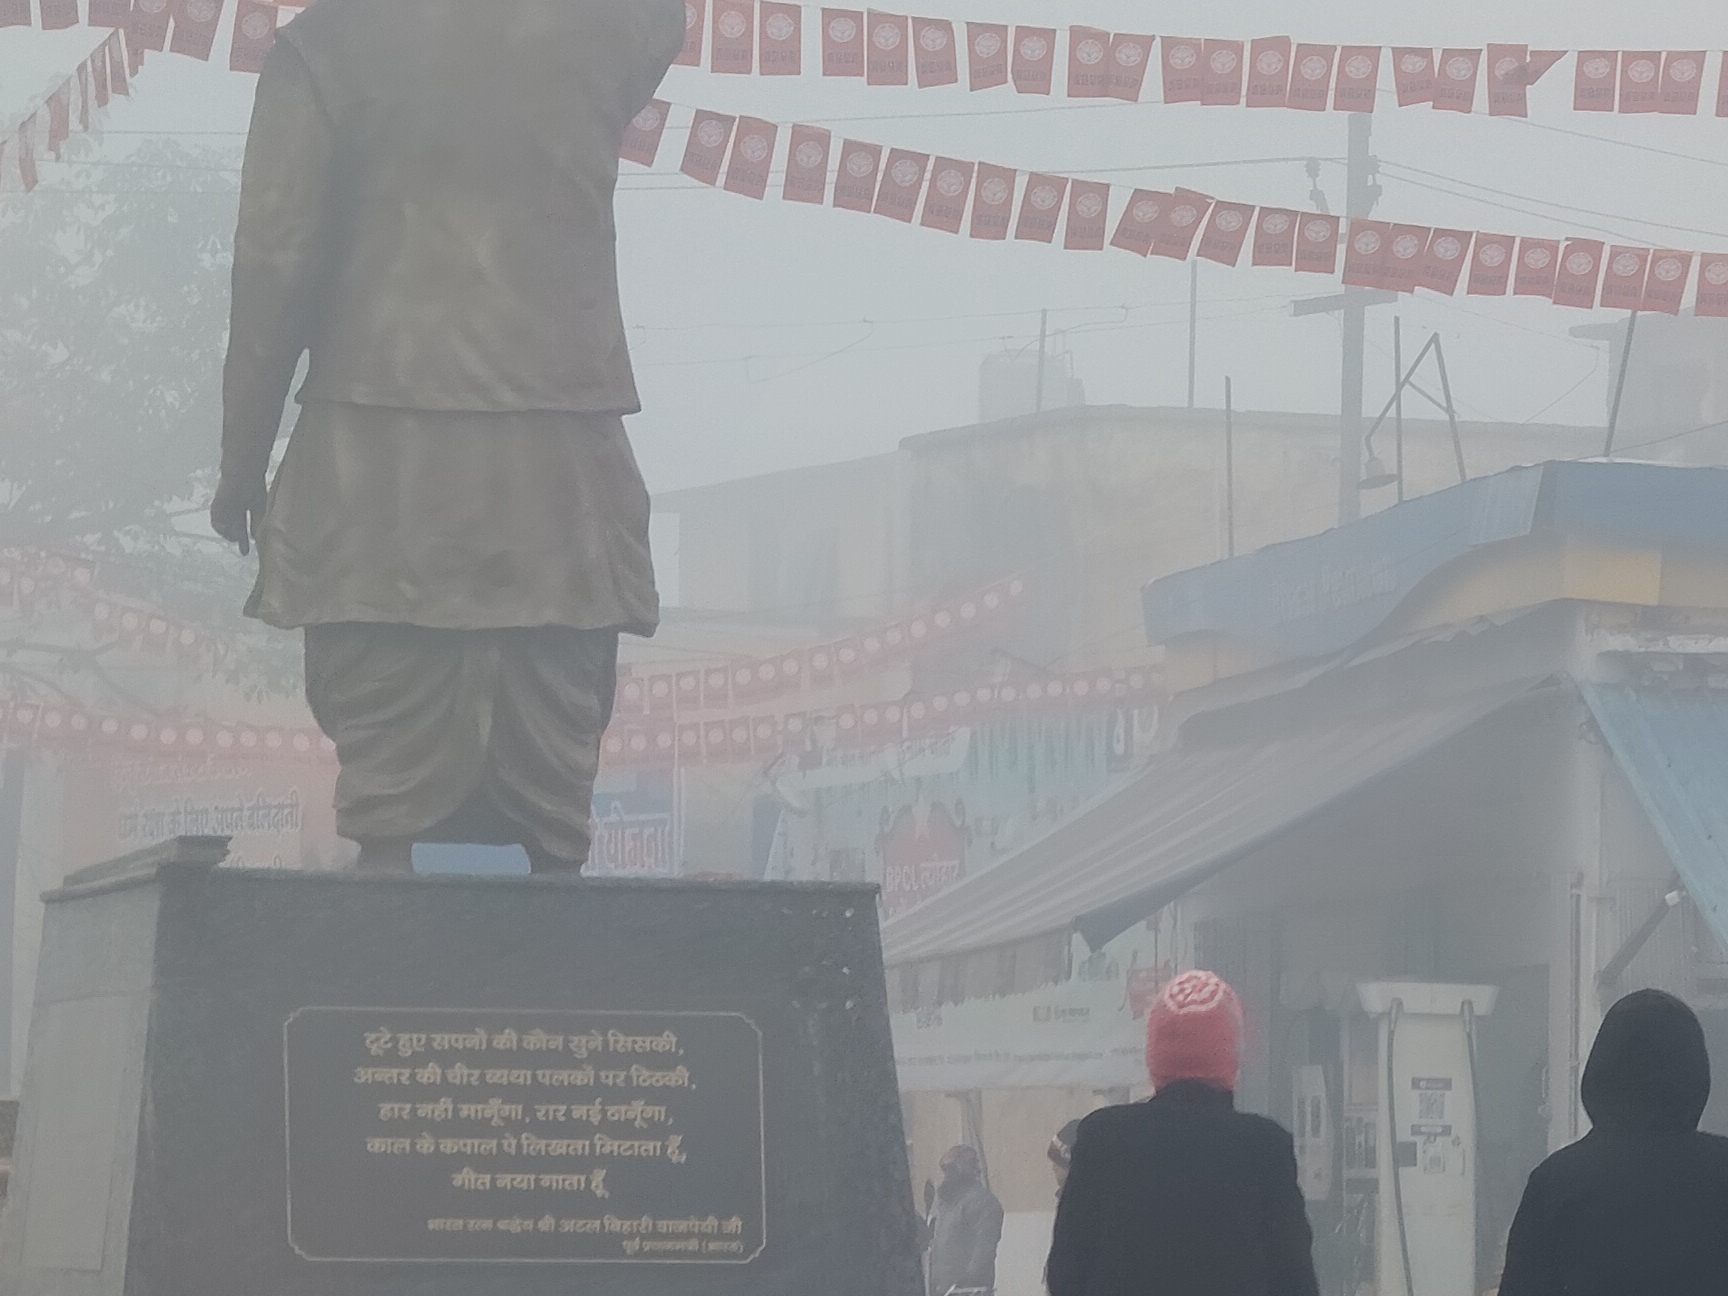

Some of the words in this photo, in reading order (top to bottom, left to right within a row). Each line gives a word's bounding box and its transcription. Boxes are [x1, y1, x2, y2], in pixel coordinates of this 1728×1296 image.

[363, 1026, 393, 1057] टूटे
[396, 1032, 427, 1057] हुए
[491, 1027, 517, 1051] की
[522, 1028, 564, 1051] कौन
[567, 1028, 603, 1058] सुने
[607, 1029, 684, 1056] सिसकी,
[353, 1066, 412, 1085] अन्तर
[415, 1061, 442, 1085] की
[599, 1069, 627, 1087] पर
[377, 1101, 412, 1121] हार
[415, 1096, 454, 1121] नहीं
[535, 1103, 567, 1121] रार
[365, 1136, 411, 1155] काल
[414, 1131, 436, 1154] के
[438, 1136, 497, 1155] कपाल
[502, 1132, 517, 1156] पे
[521, 1131, 591, 1156] लिखता
[594, 1132, 662, 1156] मिटाता
[451, 1165, 492, 1191] गीत
[495, 1173, 536, 1191] नया
[540, 1172, 587, 1191] गाता
[558, 1218, 601, 1233] अटल
[603, 1213, 653, 1234] बिहारी
